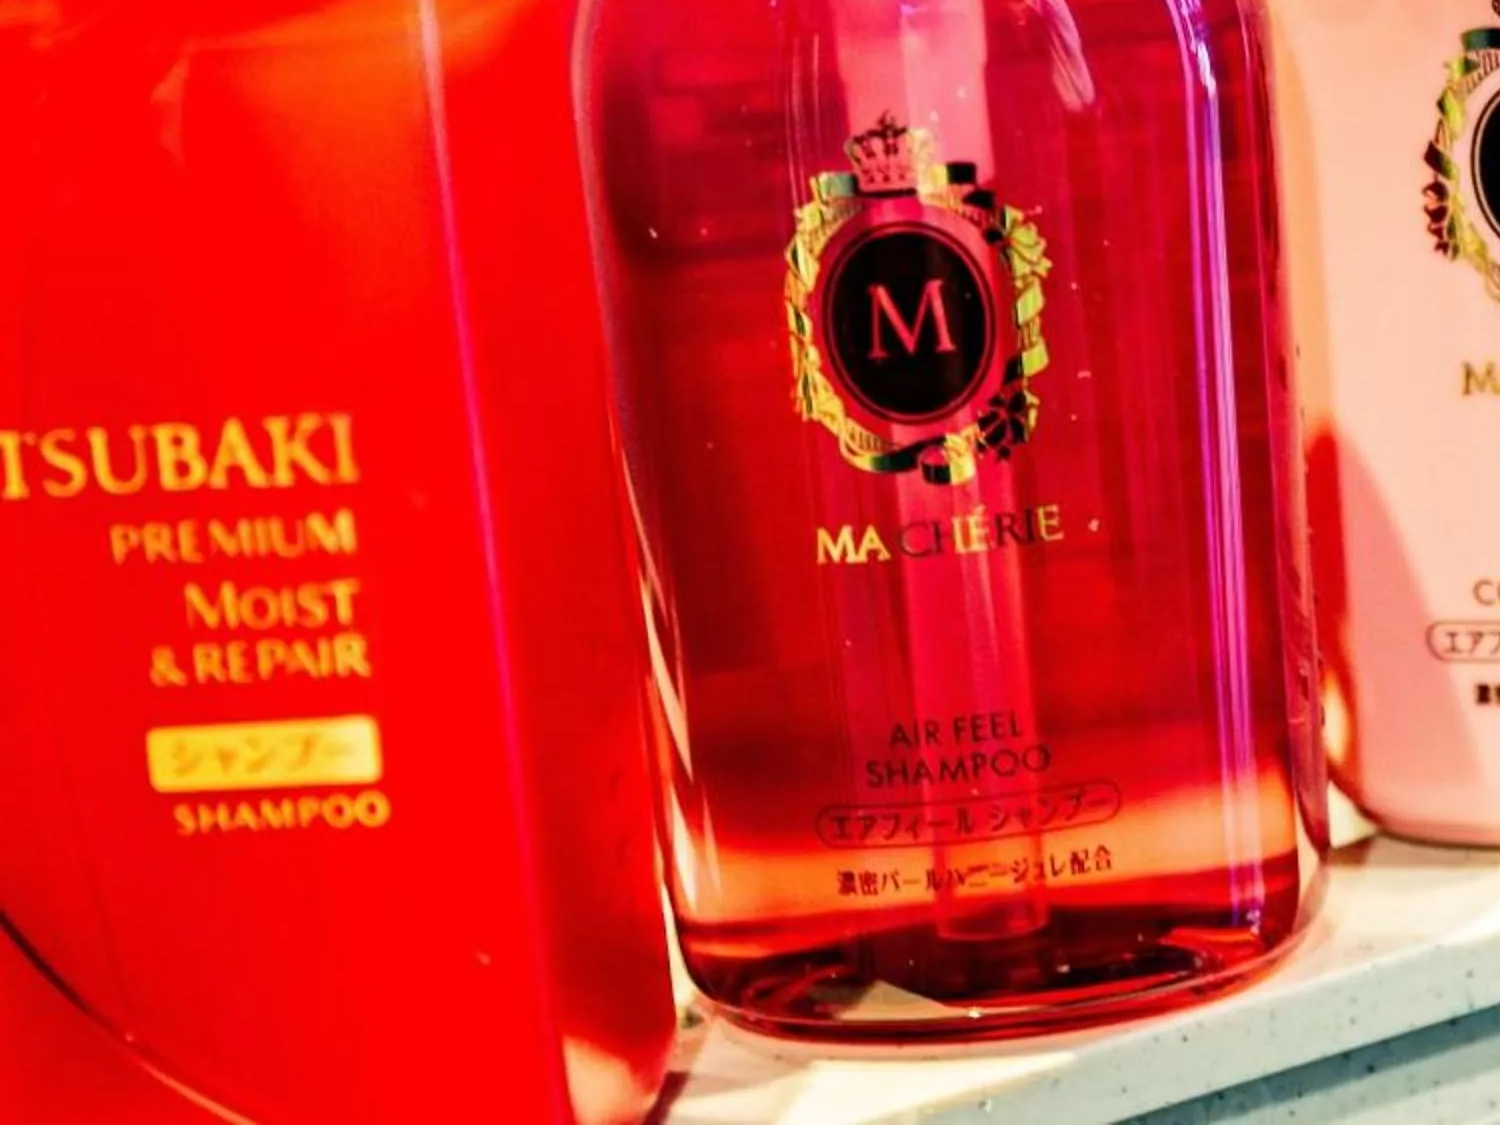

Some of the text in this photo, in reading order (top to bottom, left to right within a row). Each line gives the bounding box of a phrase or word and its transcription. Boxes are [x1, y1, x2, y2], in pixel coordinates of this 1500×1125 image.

[867, 279, 955, 359] M
[0, 412, 360, 500] TSUBAKI
[110, 508, 357, 565] PREMIUM
[817, 524, 890, 564] MA
[150, 632, 371, 687] & REPAIR
[889, 710, 1021, 748] AIR FEEL
[865, 744, 1051, 789] SHAMPOO
[174, 790, 391, 837] SHAMPOO
